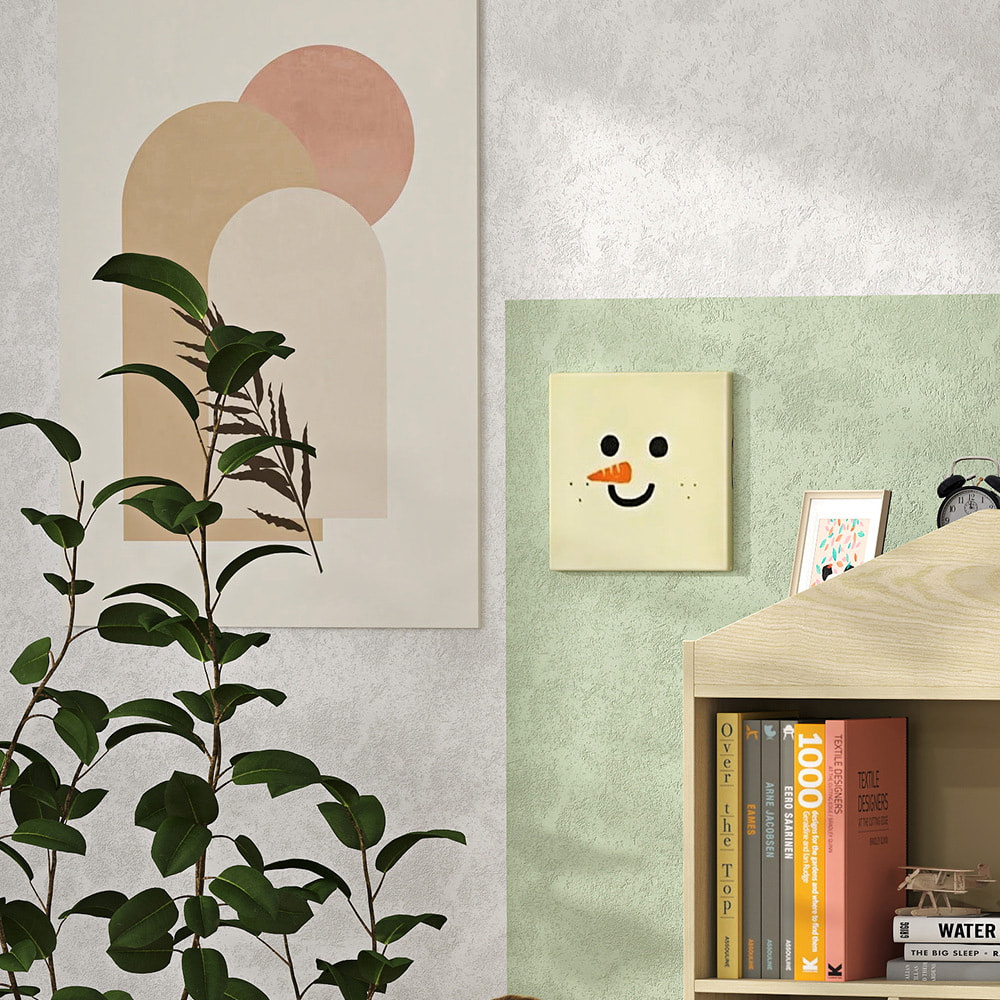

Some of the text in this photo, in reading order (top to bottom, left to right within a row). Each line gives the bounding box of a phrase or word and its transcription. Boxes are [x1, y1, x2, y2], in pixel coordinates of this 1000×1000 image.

[958, 496, 964, 504] 11
[968, 493, 976, 501] 12
[949, 505, 956, 513] 10
[797, 733, 824, 809] 1000
[833, 734, 843, 815] TEXTILE DESIGNERS
[857, 770, 880, 789] TEXTILE
[857, 793, 889, 813] DESIGNERS
[721, 722, 733, 915] Over the Top
[746, 803, 756, 835] EAMES
[765, 782, 775, 858] ARNE JACOBSEN
[784, 785, 794, 859] EERO SAARINEN
[811, 810, 819, 834] designs
[802, 840, 810, 852] and
[811, 835, 819, 844] for
[811, 845, 819, 855] the
[810, 856, 819, 881] gardens
[811, 882, 819, 894] and
[811, 895, 819, 914] where
[811, 923, 819, 935] find
[938, 922, 996, 939] WATER
[811, 936, 819, 953] them
[932, 949, 949, 957] BIG
[953, 949, 979, 957] SLEEP
